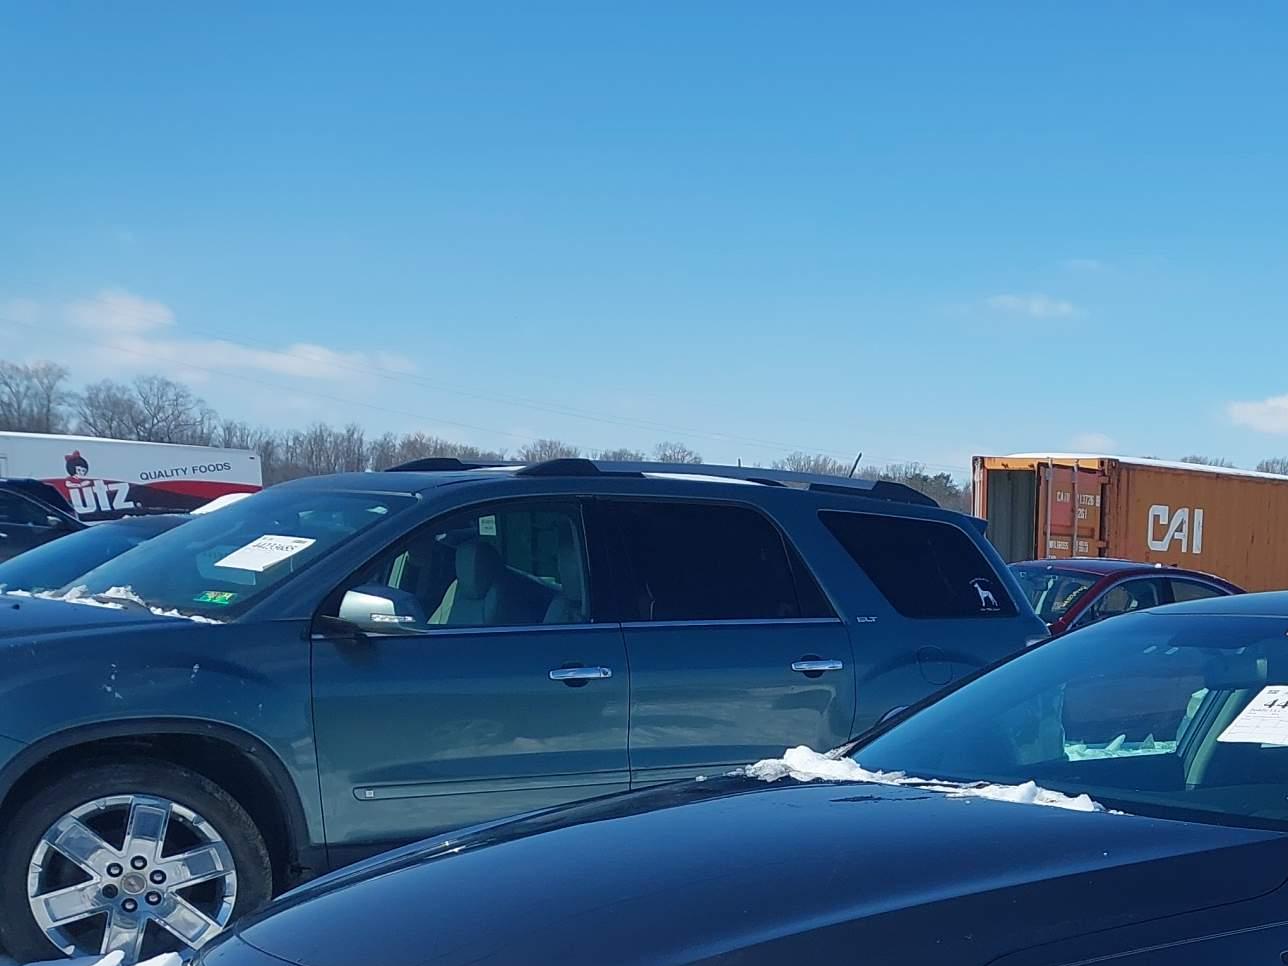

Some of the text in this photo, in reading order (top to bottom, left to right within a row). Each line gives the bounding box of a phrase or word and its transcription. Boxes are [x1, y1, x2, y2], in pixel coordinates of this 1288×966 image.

[139, 462, 231, 482] QUALITY FOODS
[1147, 504, 1204, 554] CAI
